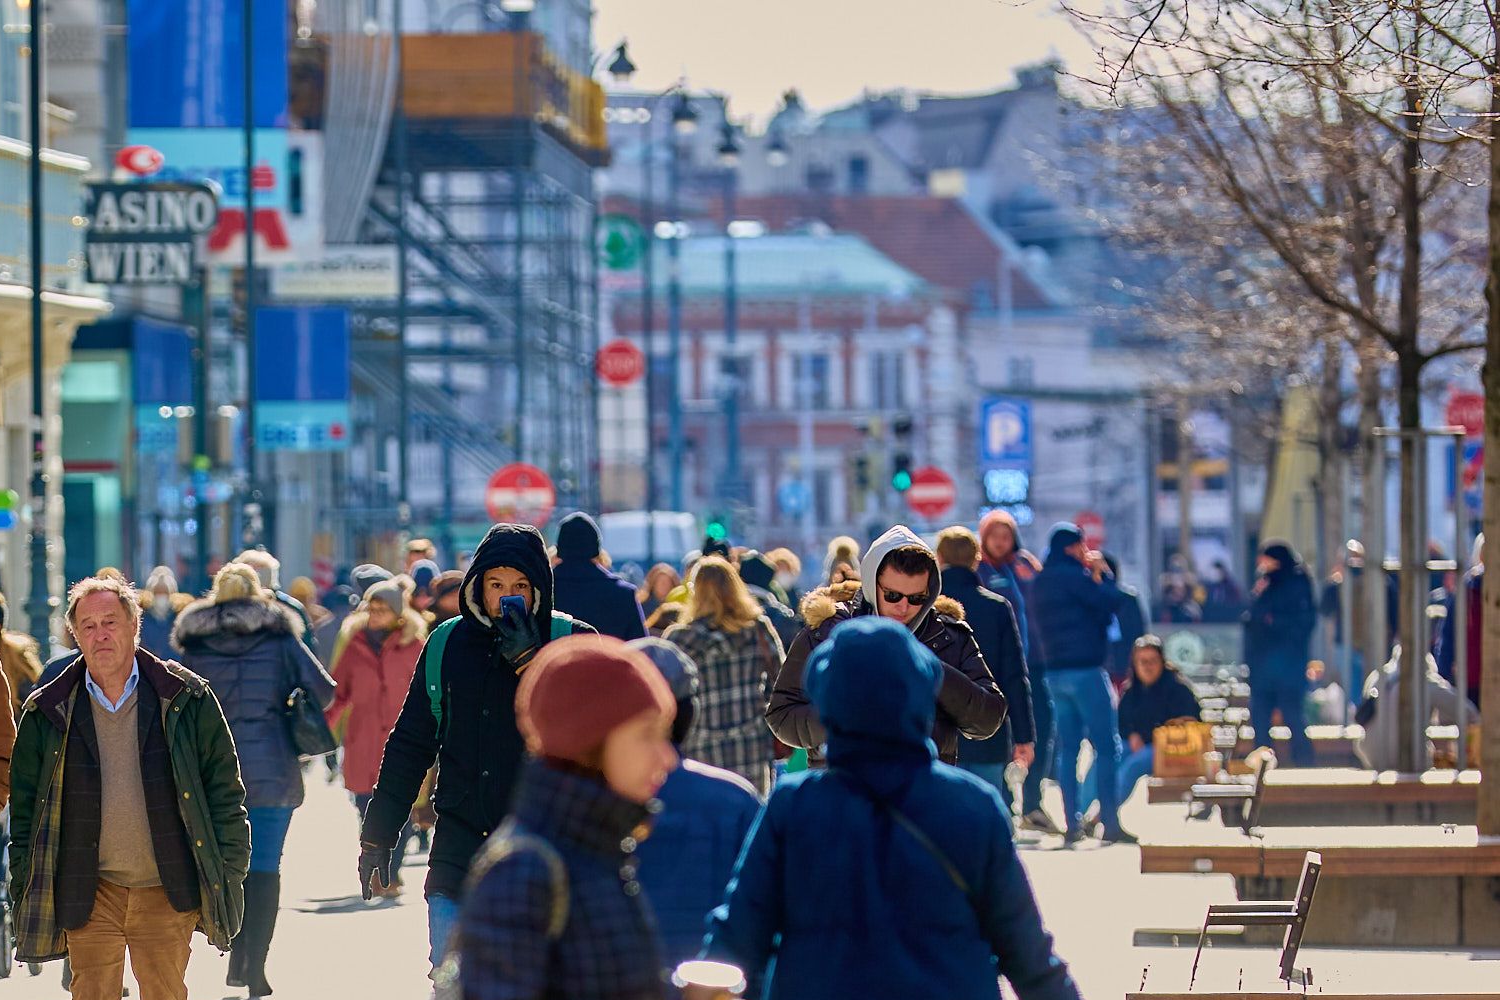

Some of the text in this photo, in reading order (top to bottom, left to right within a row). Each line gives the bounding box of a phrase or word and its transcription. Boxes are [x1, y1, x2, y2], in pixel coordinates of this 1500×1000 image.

[85, 188, 216, 232] ASINO
[87, 241, 190, 282] WIEN
[989, 411, 1023, 454] P
